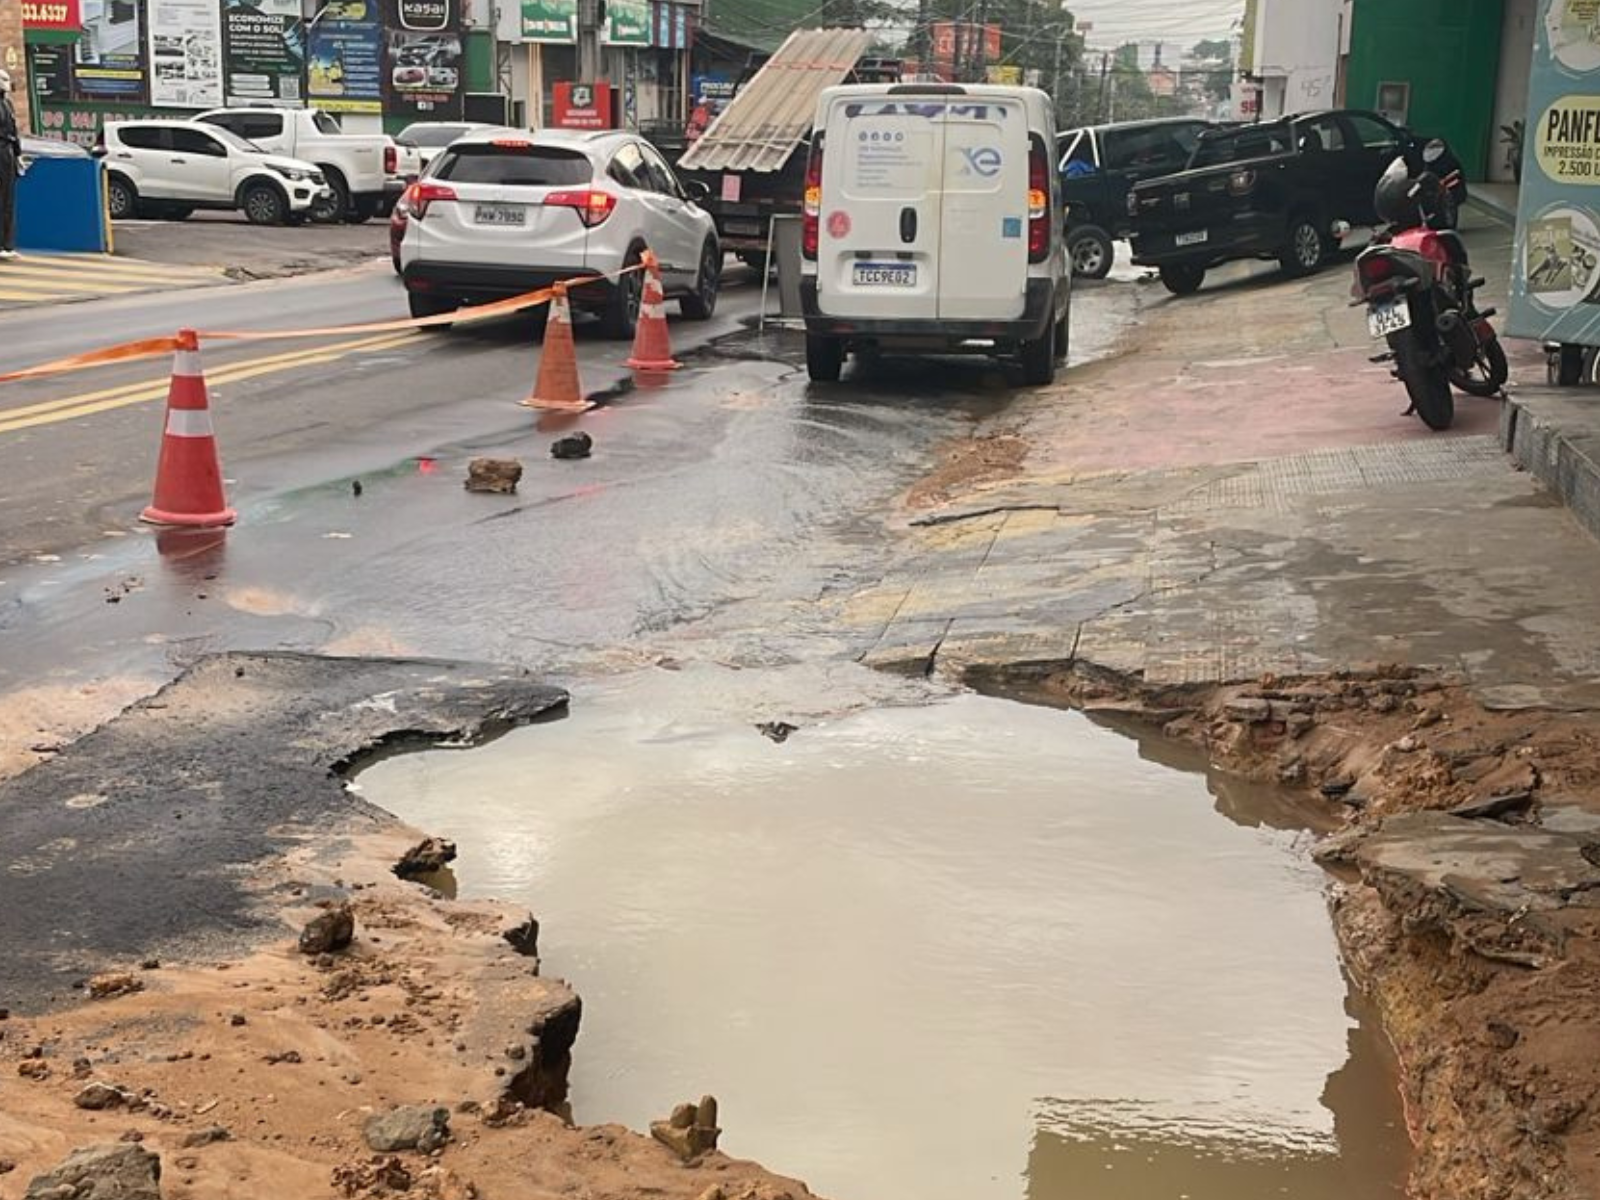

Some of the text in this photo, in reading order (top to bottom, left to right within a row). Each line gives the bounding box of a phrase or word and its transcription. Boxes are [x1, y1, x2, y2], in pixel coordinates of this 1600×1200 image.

[229, 15, 284, 24] ECONOMIZE
[229, 24, 251, 32] COM
[1544, 145, 1592, 159] IMPRESSÃO
[1558, 160, 1591, 176] 2.500
